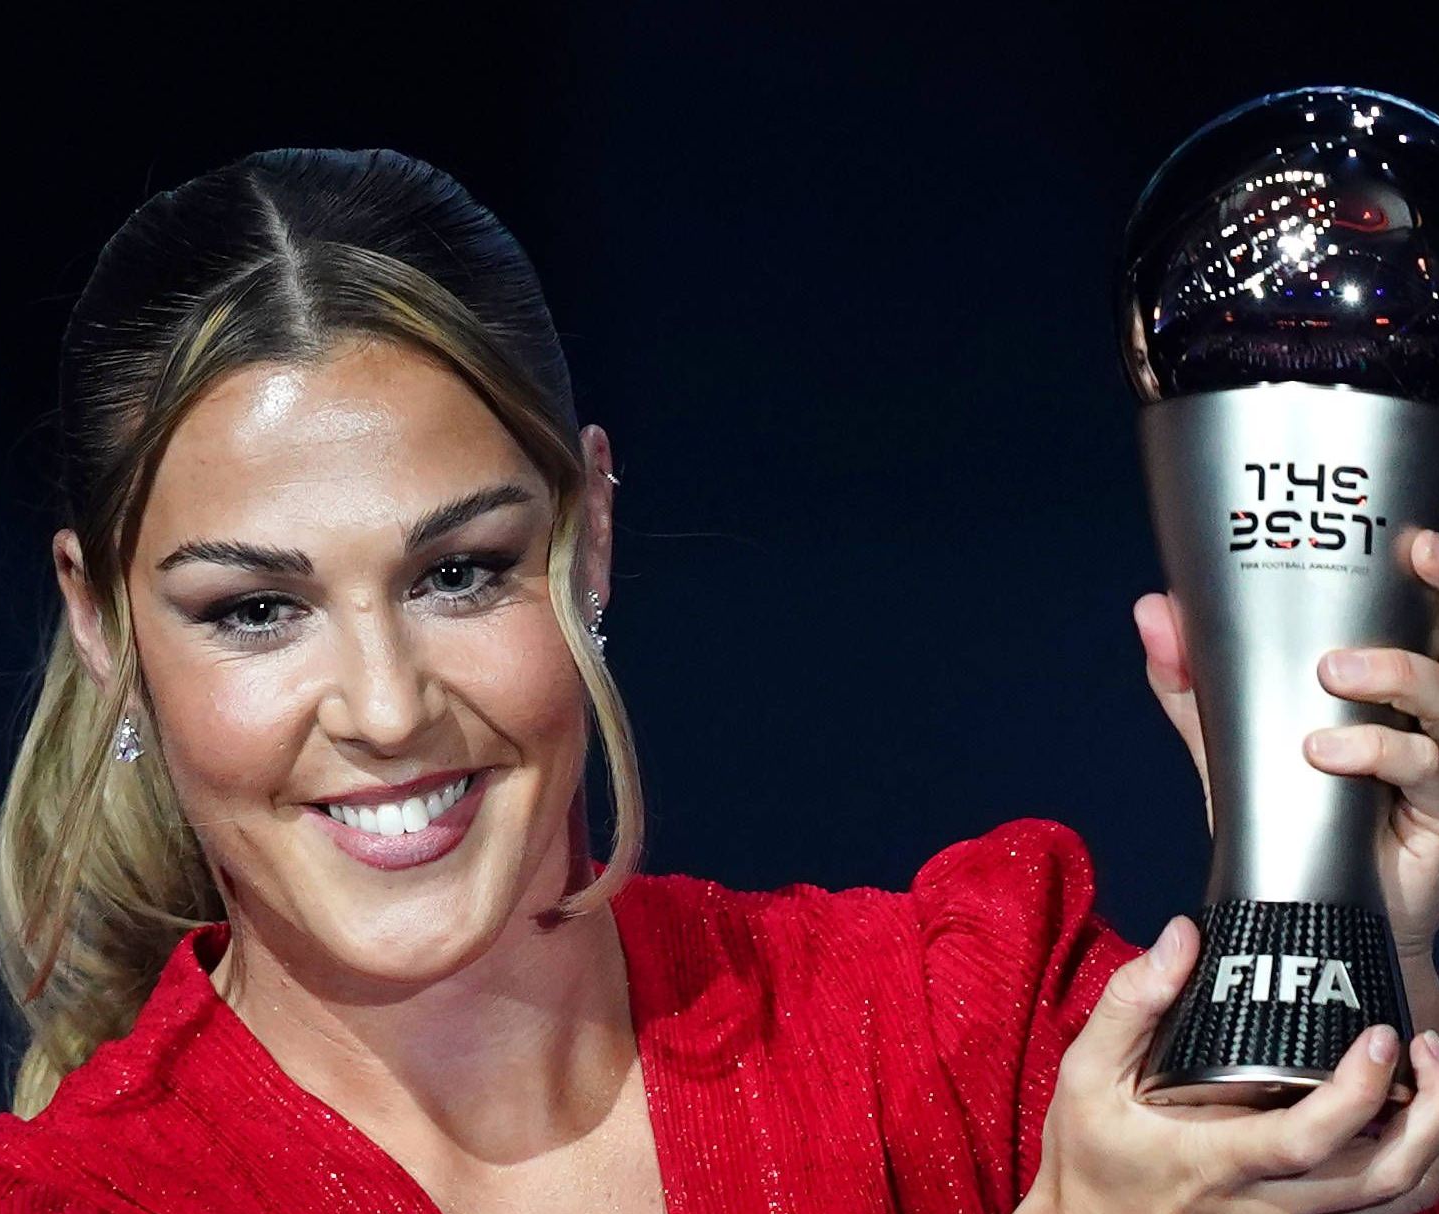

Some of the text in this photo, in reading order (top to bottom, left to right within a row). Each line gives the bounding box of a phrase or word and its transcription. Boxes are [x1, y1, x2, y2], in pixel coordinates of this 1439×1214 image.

[1245, 463, 1370, 505] THE
[1229, 510, 1387, 555] BEST
[1211, 953, 1361, 1010] FIFA
